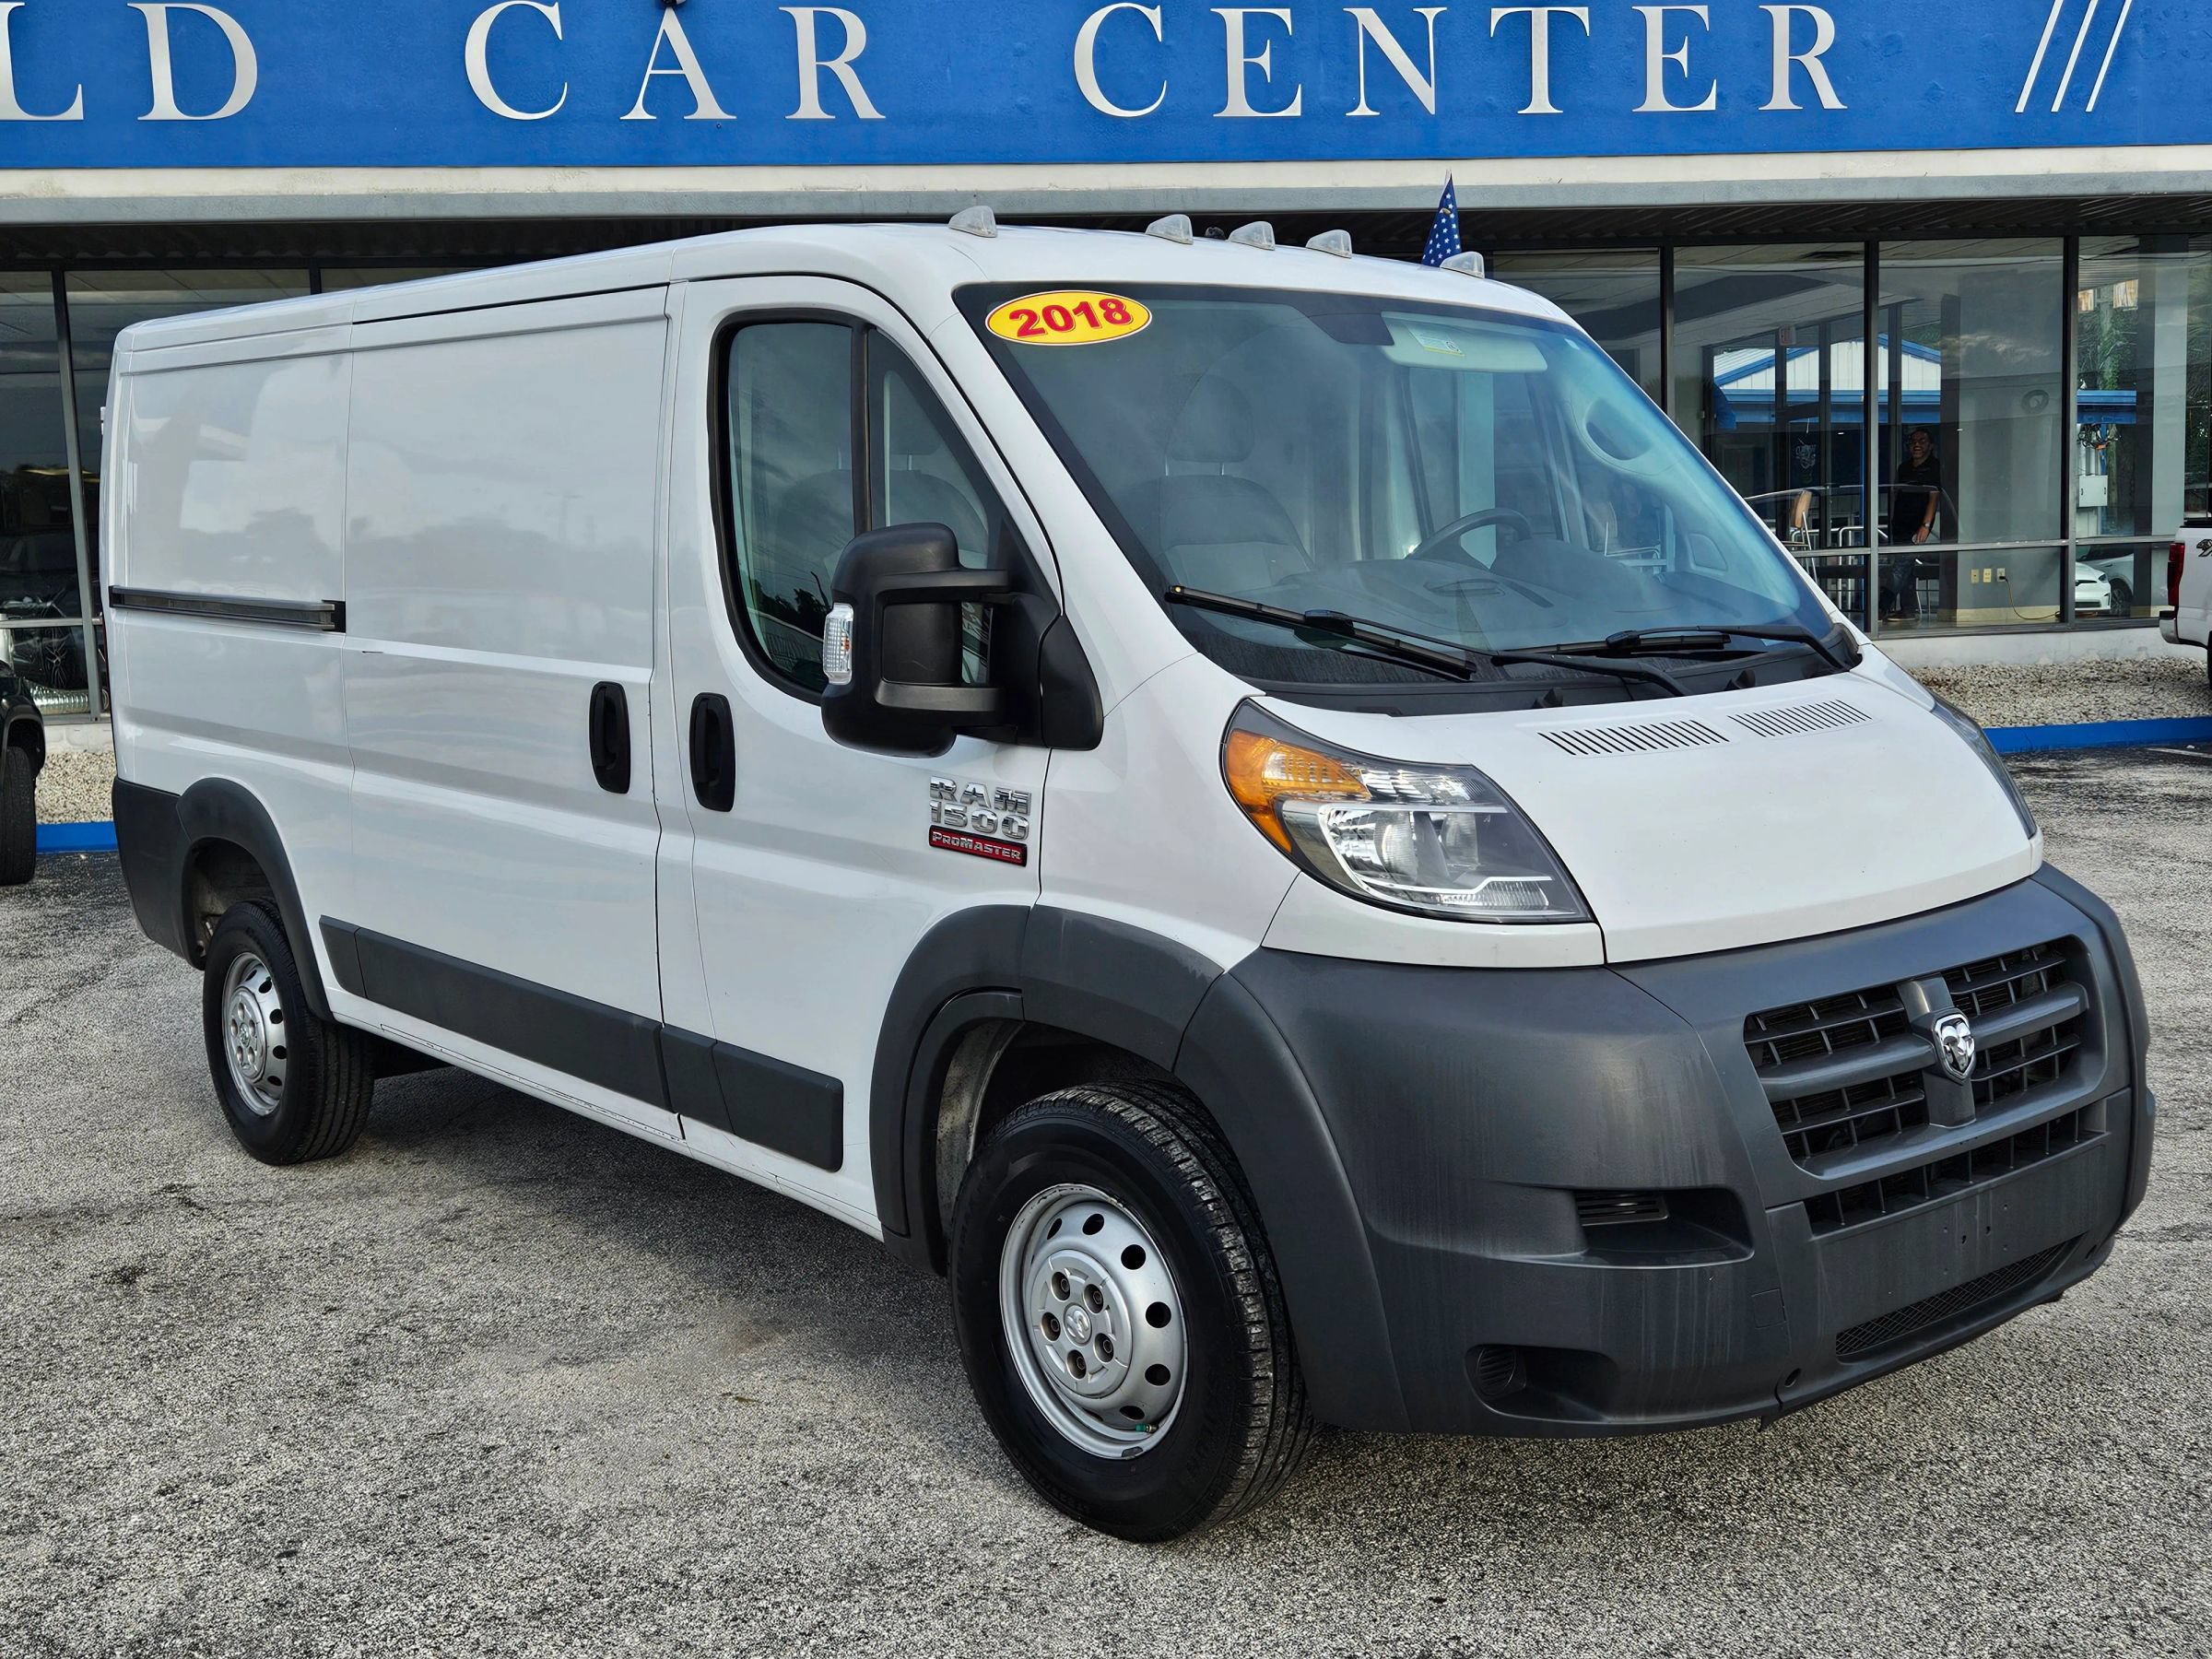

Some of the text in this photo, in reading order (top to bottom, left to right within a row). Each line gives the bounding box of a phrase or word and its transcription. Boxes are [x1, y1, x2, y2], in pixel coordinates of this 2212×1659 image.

[464, 0, 886, 121] CAR
[1073, 2, 1848, 118] CENTER
[1008, 298, 1134, 338] 2018
[929, 776, 1032, 817] RAM
[929, 799, 1030, 841] 1500
